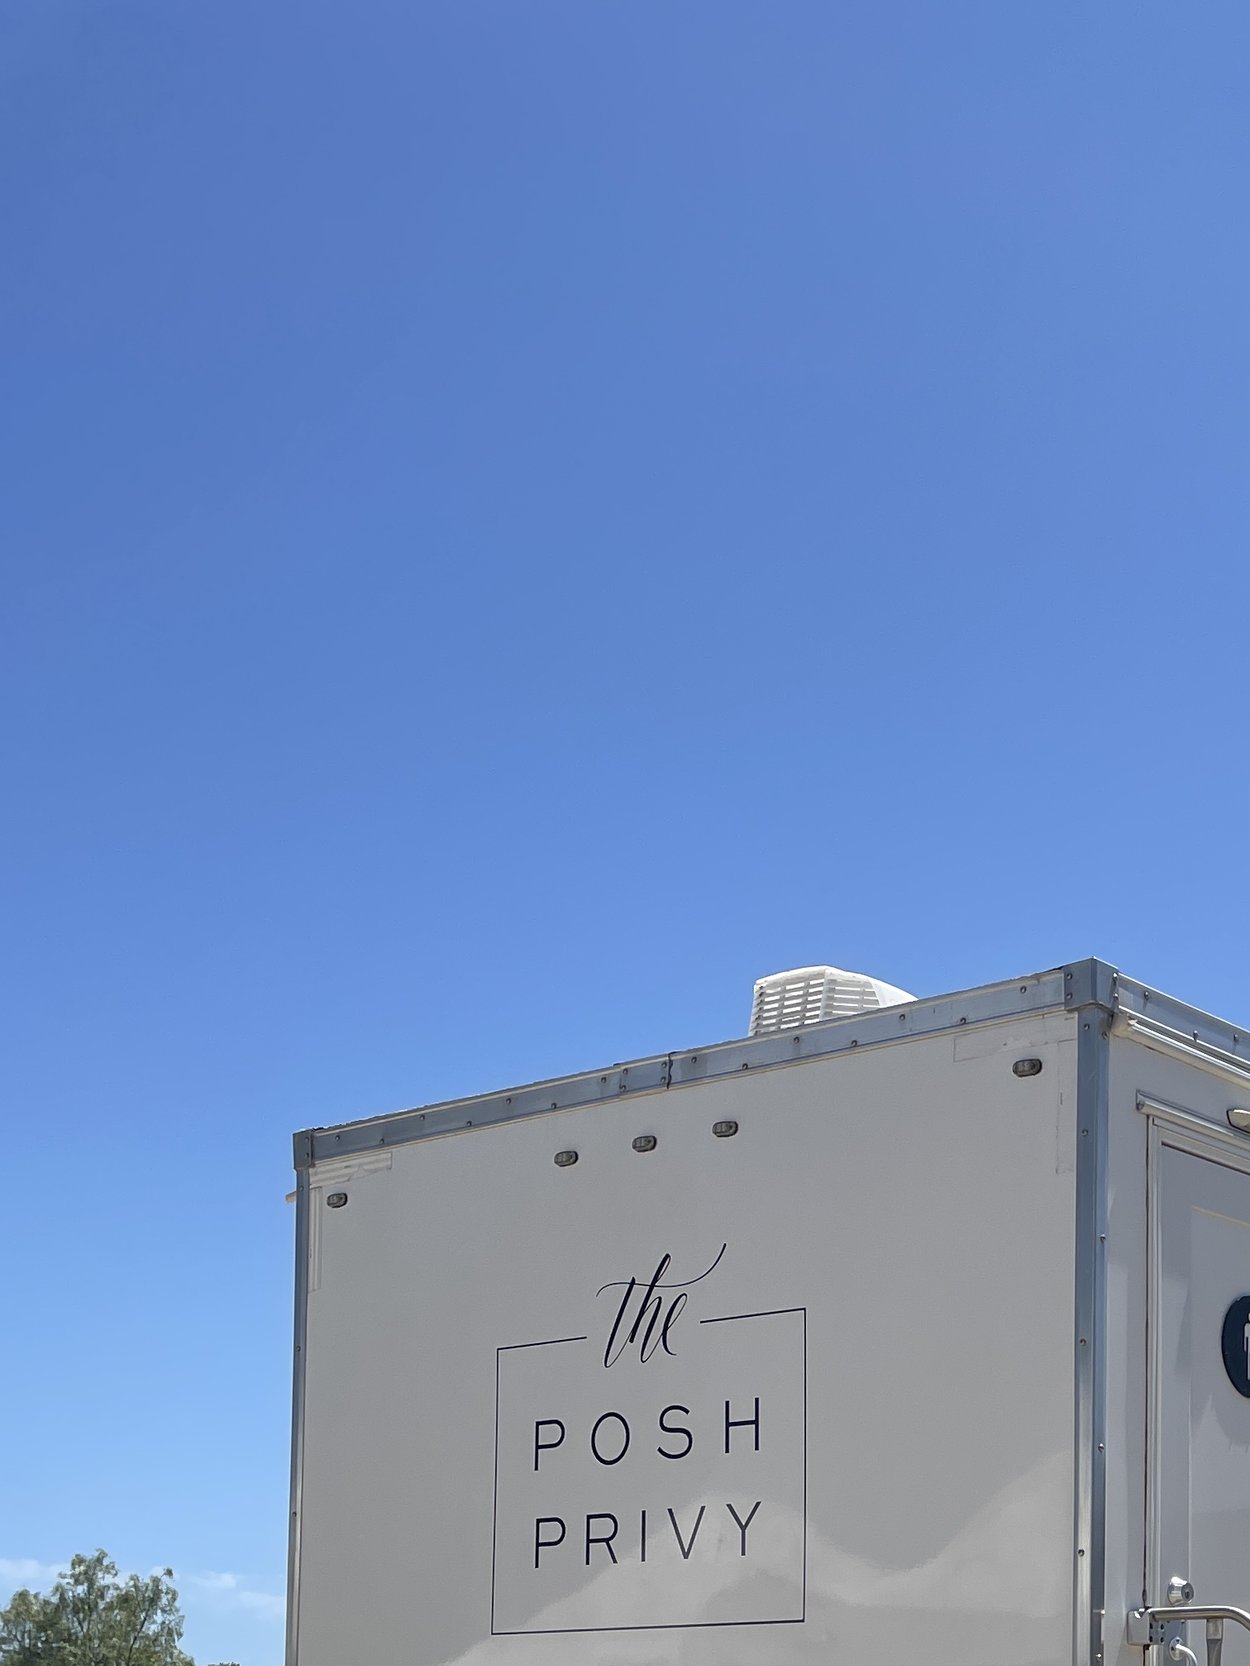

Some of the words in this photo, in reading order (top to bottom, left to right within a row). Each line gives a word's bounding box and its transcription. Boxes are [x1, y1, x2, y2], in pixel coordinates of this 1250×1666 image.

[596, 1243, 727, 1369] the
[534, 1398, 760, 1472] POSH
[534, 1501, 762, 1569] PRIVY
